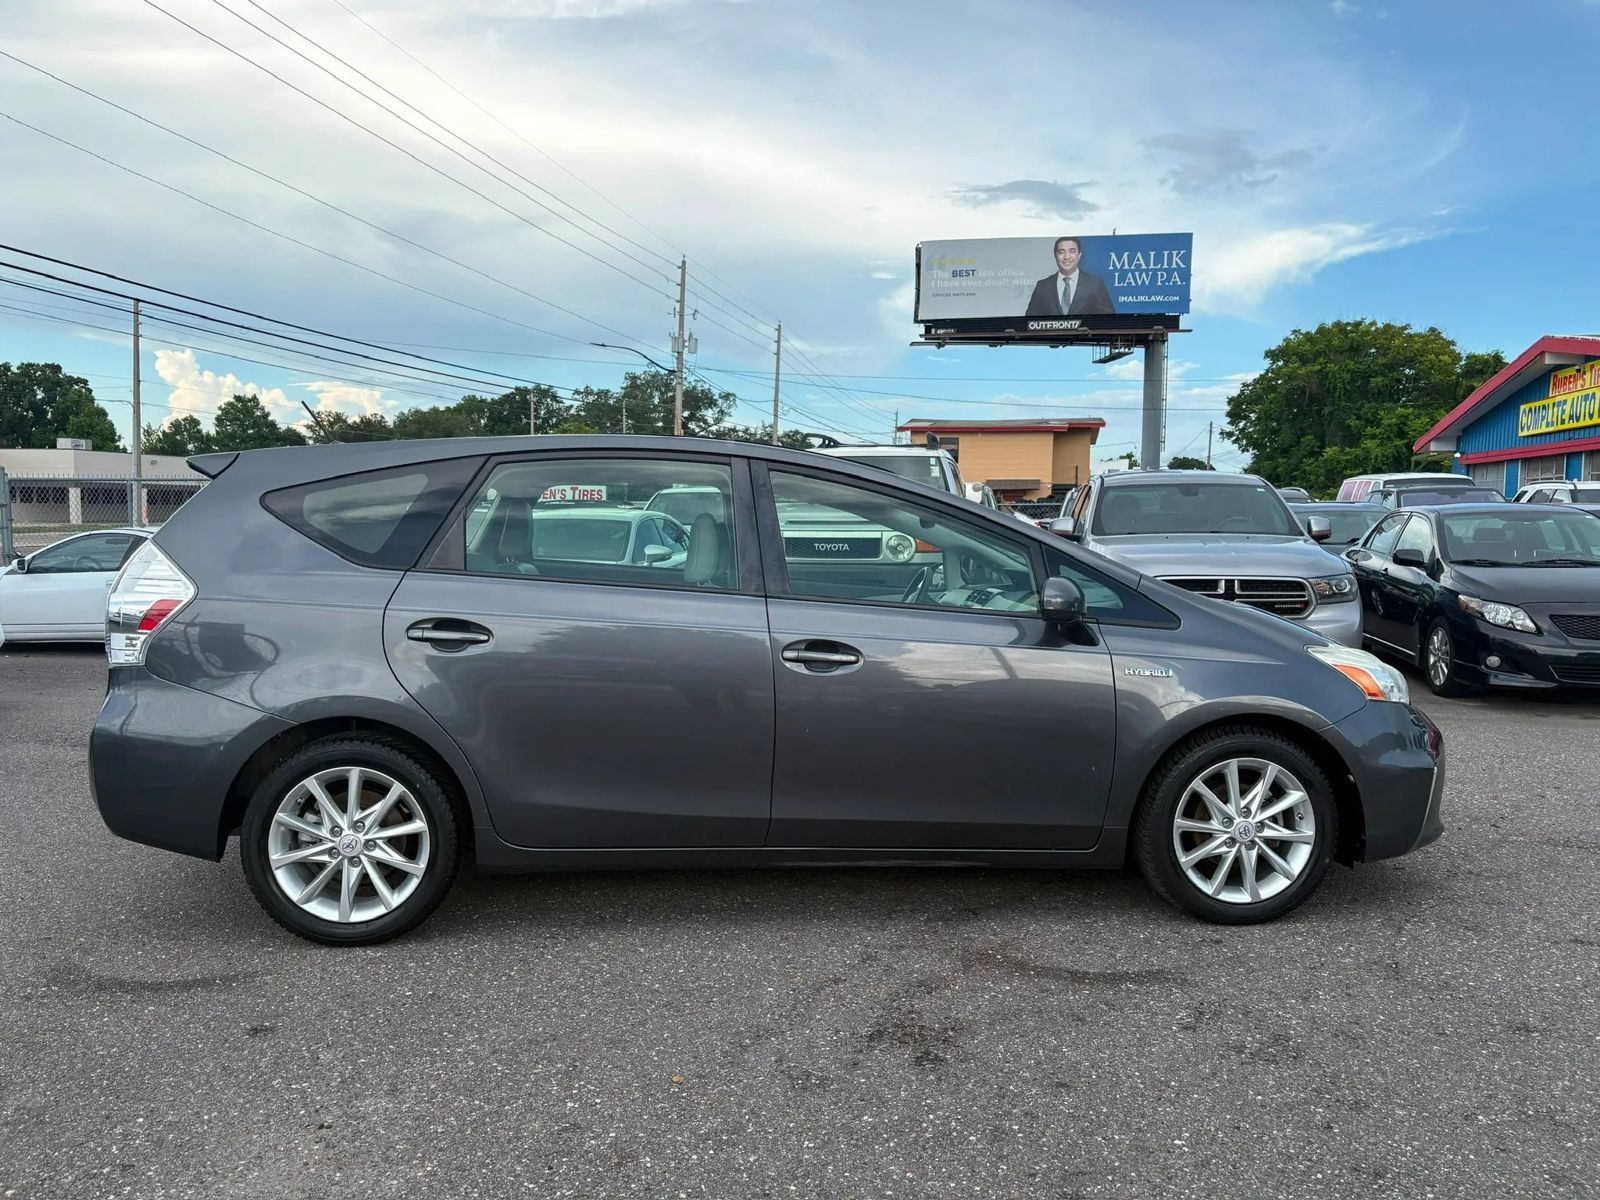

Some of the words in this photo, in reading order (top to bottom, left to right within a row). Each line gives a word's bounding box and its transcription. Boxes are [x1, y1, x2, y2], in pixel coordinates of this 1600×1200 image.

[1108, 250, 1187, 270] MALIK
[951, 269, 977, 278] BEST
[1113, 272, 1152, 287] LAW
[1156, 271, 1187, 286] P.A.
[1551, 370, 1587, 395] RUBEN'S
[1520, 399, 1568, 432] COMPLETE
[1568, 391, 1596, 425] AUTO
[570, 486, 604, 500] TIRES
[813, 543, 850, 551] TOYOTA
[1124, 667, 1166, 677] HYBRID
